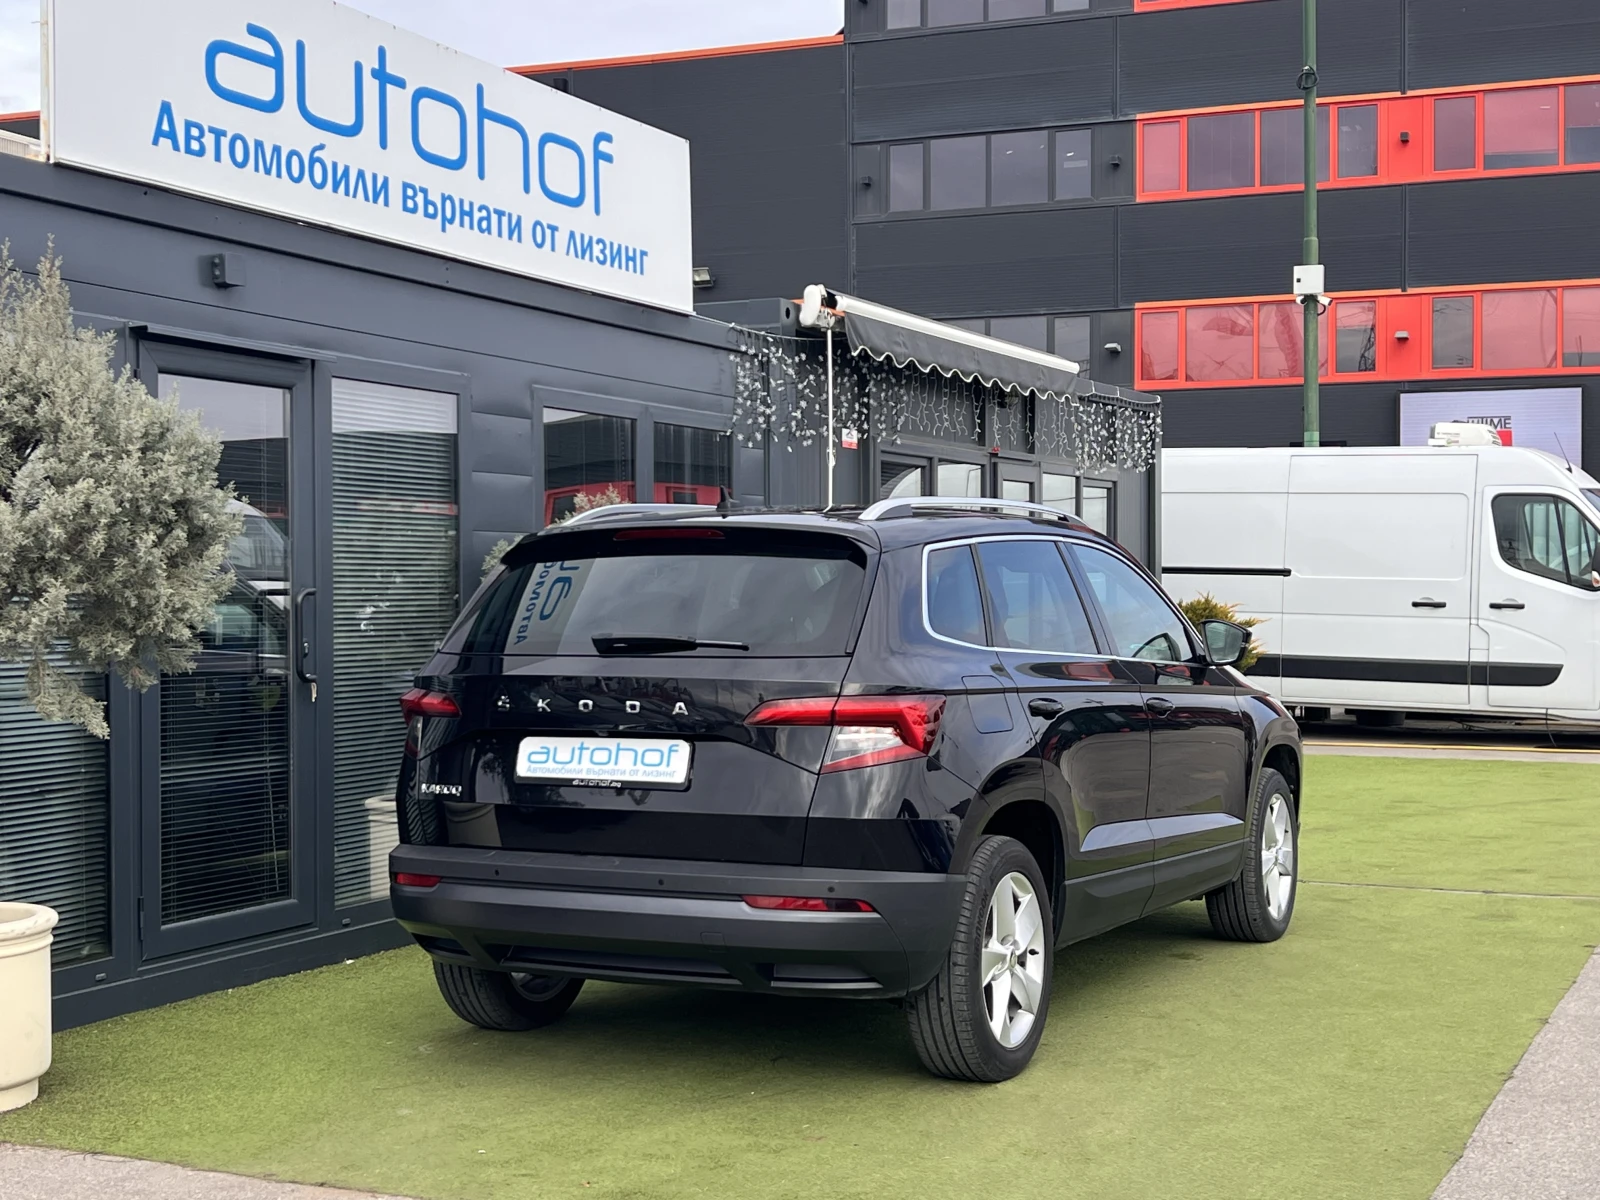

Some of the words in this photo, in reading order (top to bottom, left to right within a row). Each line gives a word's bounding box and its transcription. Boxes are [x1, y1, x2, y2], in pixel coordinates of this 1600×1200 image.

[204, 22, 614, 216] autohof
[151, 99, 390, 208] Автомобили
[402, 180, 523, 244] върнати
[531, 219, 560, 252] от
[565, 229, 649, 276] лизинг
[526, 765, 583, 776] Автомобили
[585, 767, 627, 778] върнати
[628, 768, 640, 777] от
[641, 769, 677, 779] лизинг
[527, 741, 680, 768] autohof
